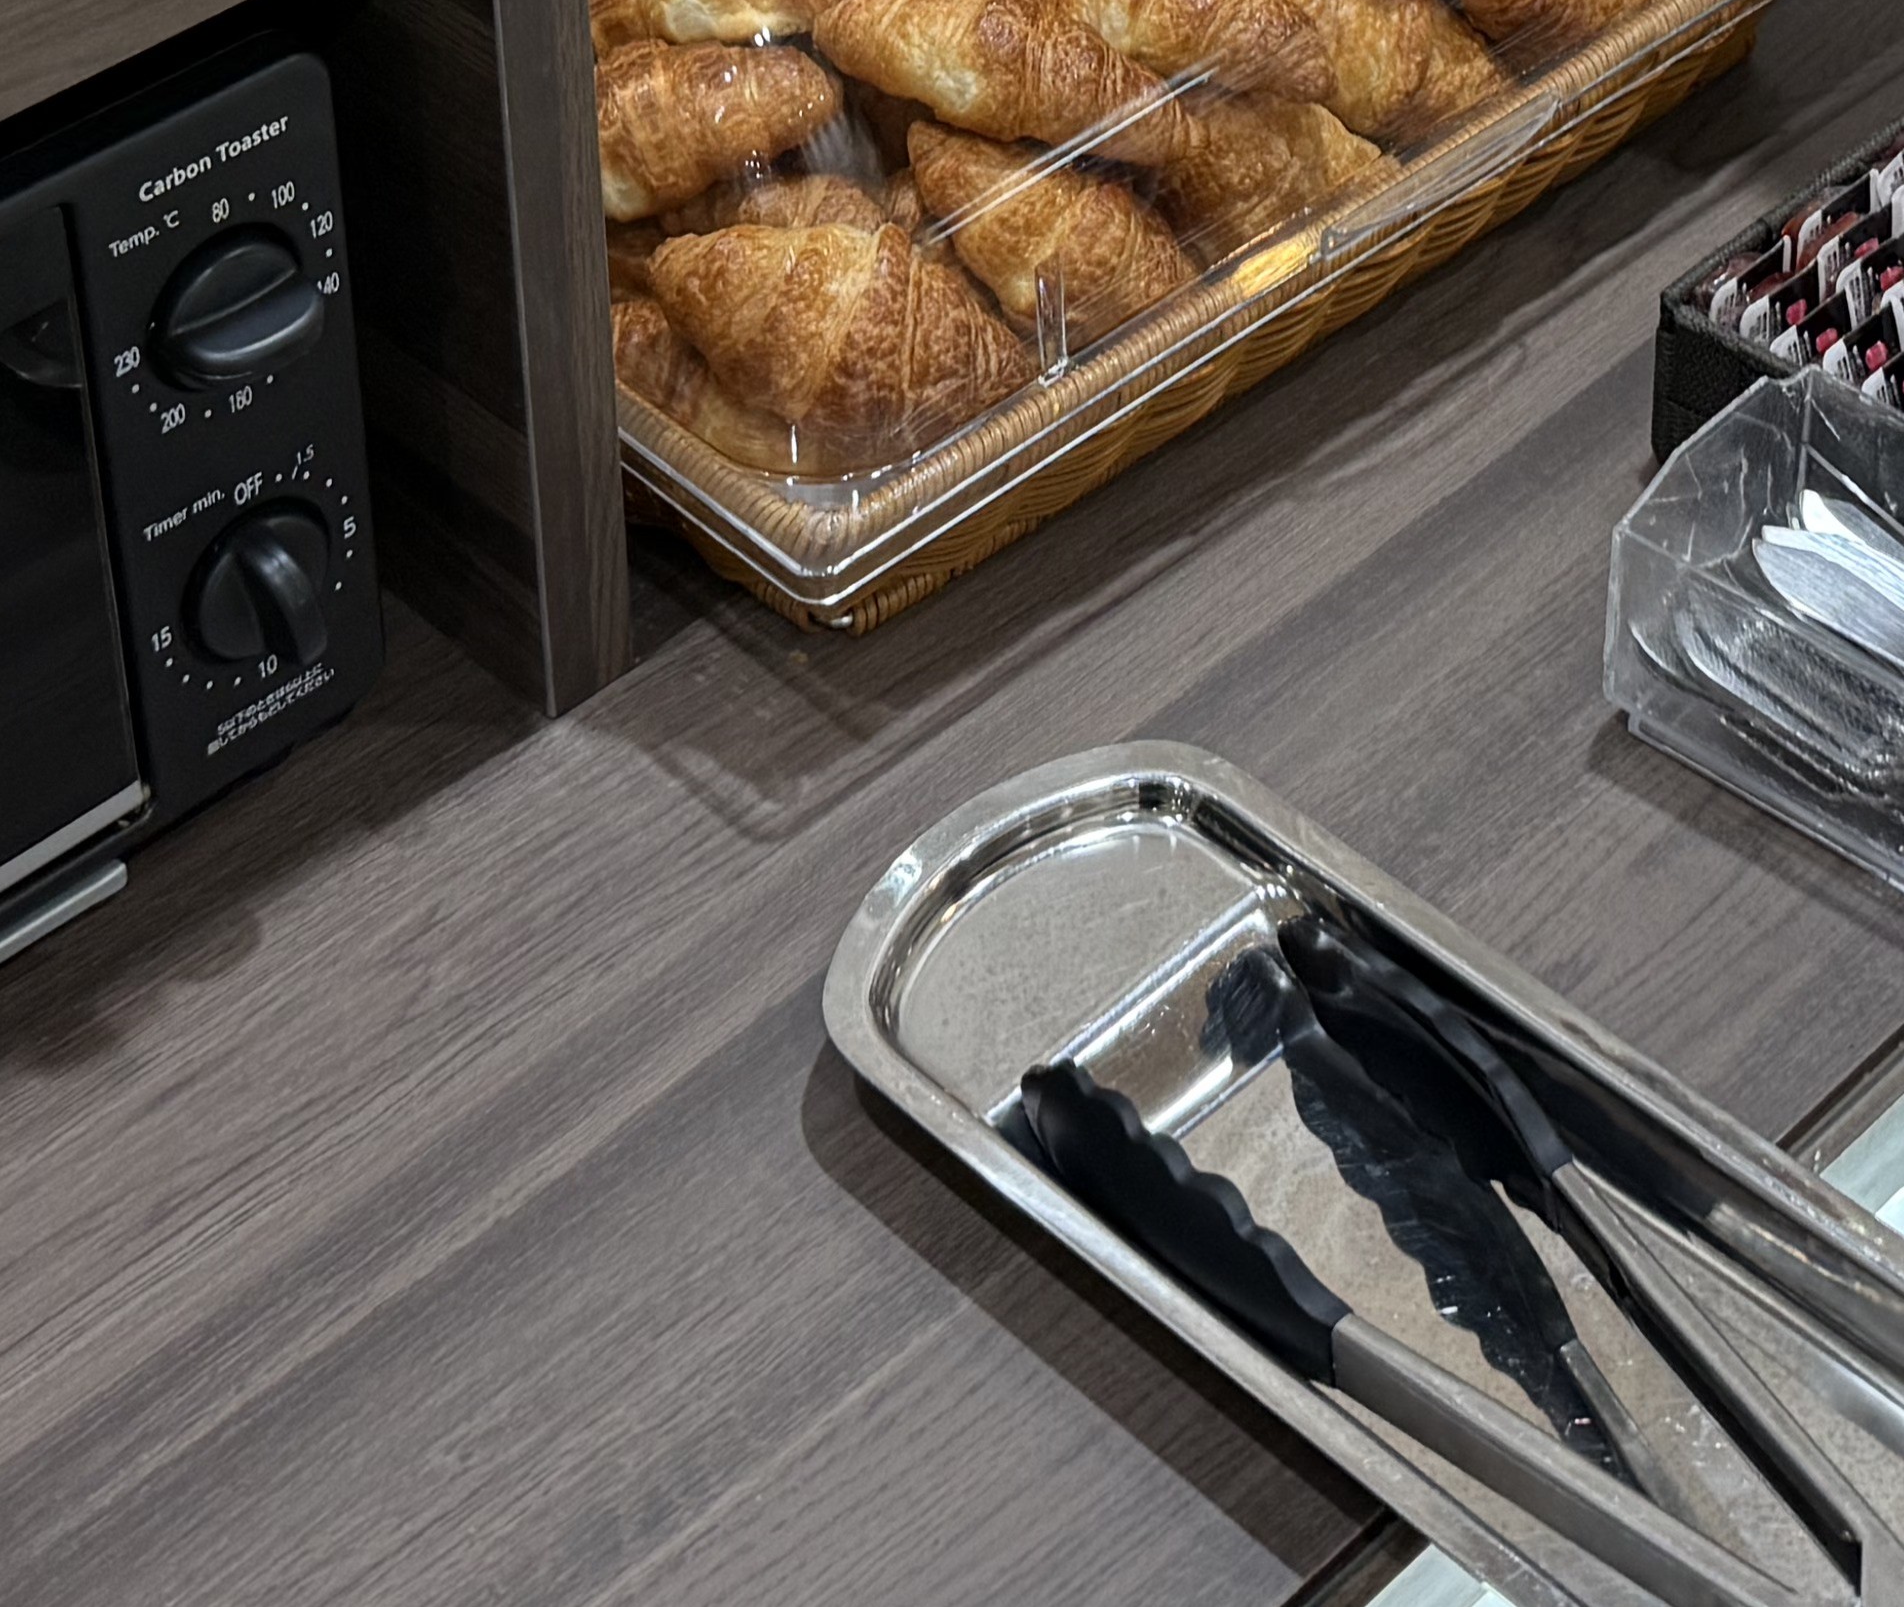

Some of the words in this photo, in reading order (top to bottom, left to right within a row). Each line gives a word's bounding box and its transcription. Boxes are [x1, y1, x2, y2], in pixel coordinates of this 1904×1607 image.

[138, 152, 213, 204] Carbon
[215, 114, 290, 164] Toaster
[270, 180, 296, 210] 100
[211, 197, 230, 225] 80
[309, 210, 335, 239] 120
[108, 227, 160, 259] Temp.
[114, 345, 141, 379] 230
[160, 402, 187, 435] 200
[233, 472, 265, 507] OFF
[142, 506, 190, 543] Timer
[192, 487, 226, 519] min.
[343, 516, 357, 540] 5
[151, 625, 173, 654] 15
[257, 653, 279, 681] 10
